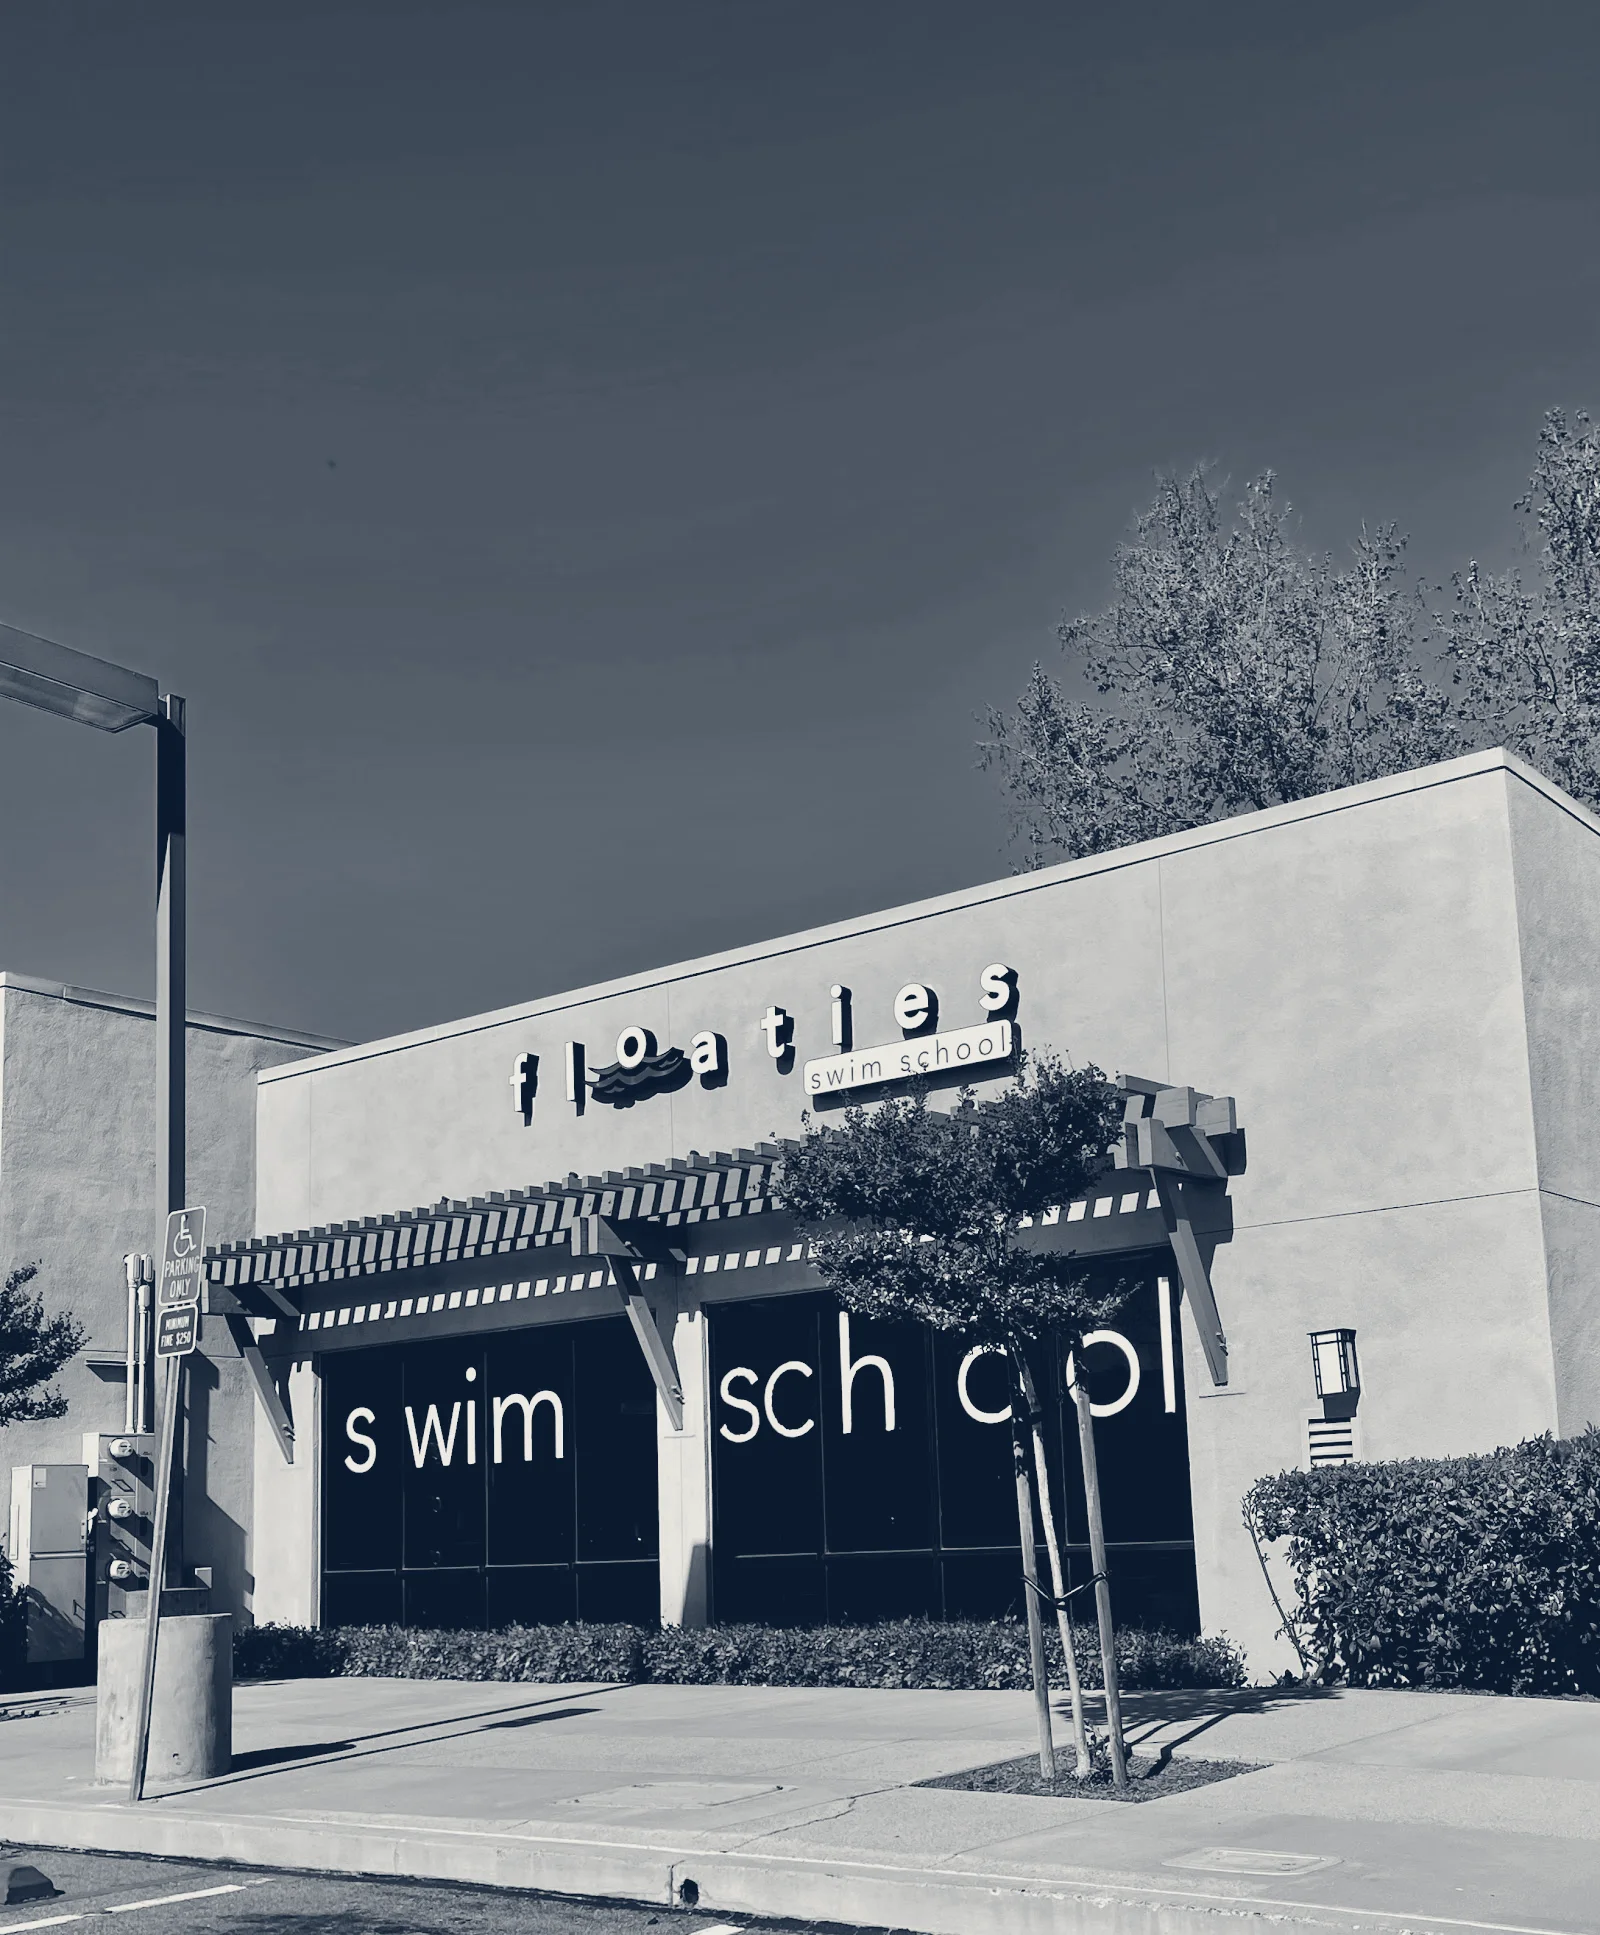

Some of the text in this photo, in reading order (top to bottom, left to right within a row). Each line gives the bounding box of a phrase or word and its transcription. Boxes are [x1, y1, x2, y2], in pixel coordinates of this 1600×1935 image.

[509, 962, 1012, 1113] floaties
[811, 1024, 1006, 1090] swim school
[165, 1257, 199, 1277] PARKING
[170, 1278, 191, 1298] ONLY
[166, 1316, 190, 1331] MINIMUM
[161, 1332, 191, 1347] FINE $250
